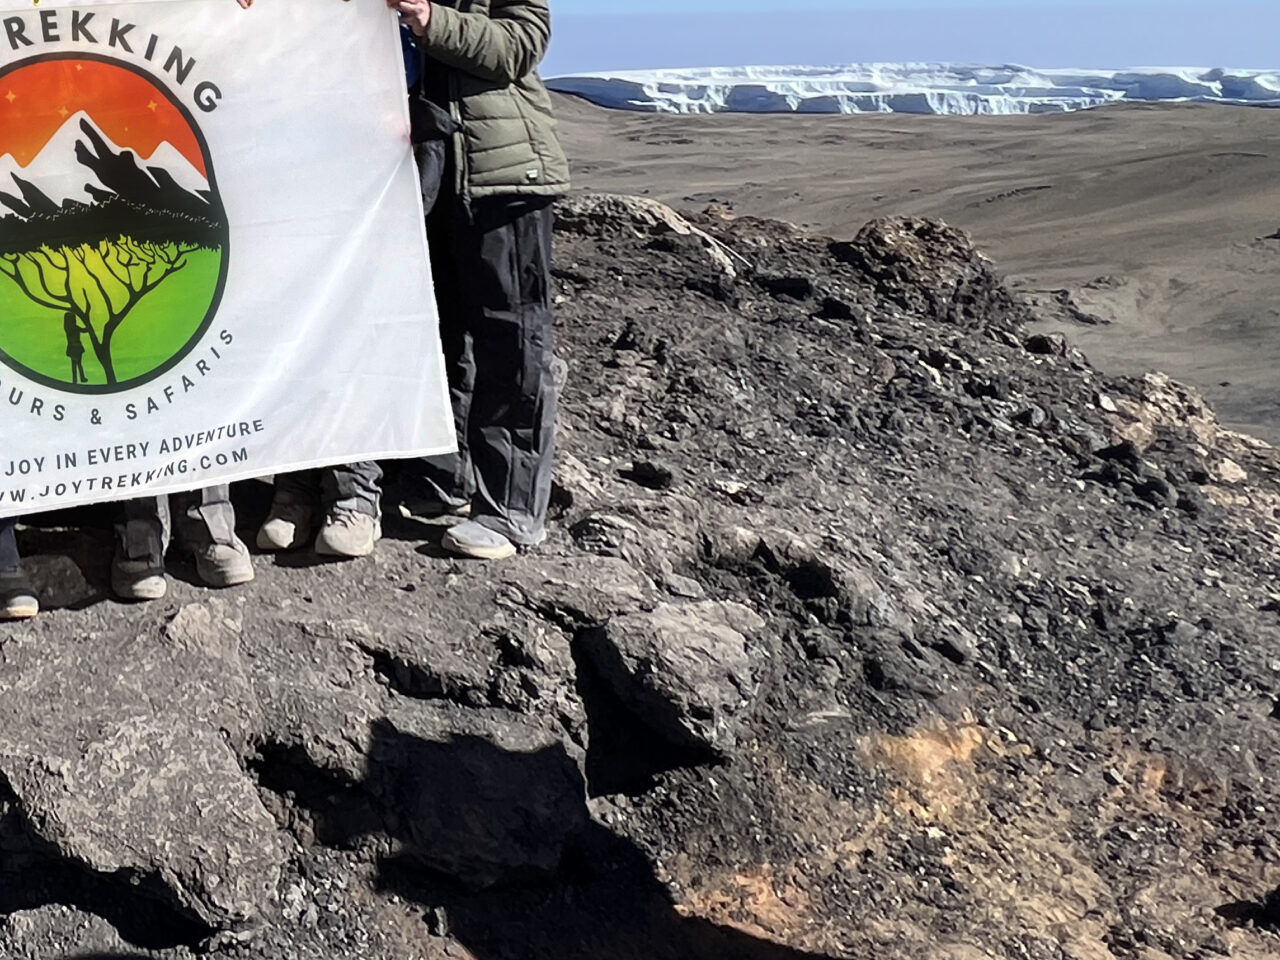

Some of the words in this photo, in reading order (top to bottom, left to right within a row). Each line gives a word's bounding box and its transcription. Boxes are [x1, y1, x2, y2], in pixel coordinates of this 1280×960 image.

[90, 408, 103, 425] &
[125, 329, 234, 420] SAFARIS
[4, 456, 46, 477] JOY
[56, 452, 78, 470] IN
[87, 441, 150, 466] EVERY
[159, 419, 265, 455] ADVENTURE
